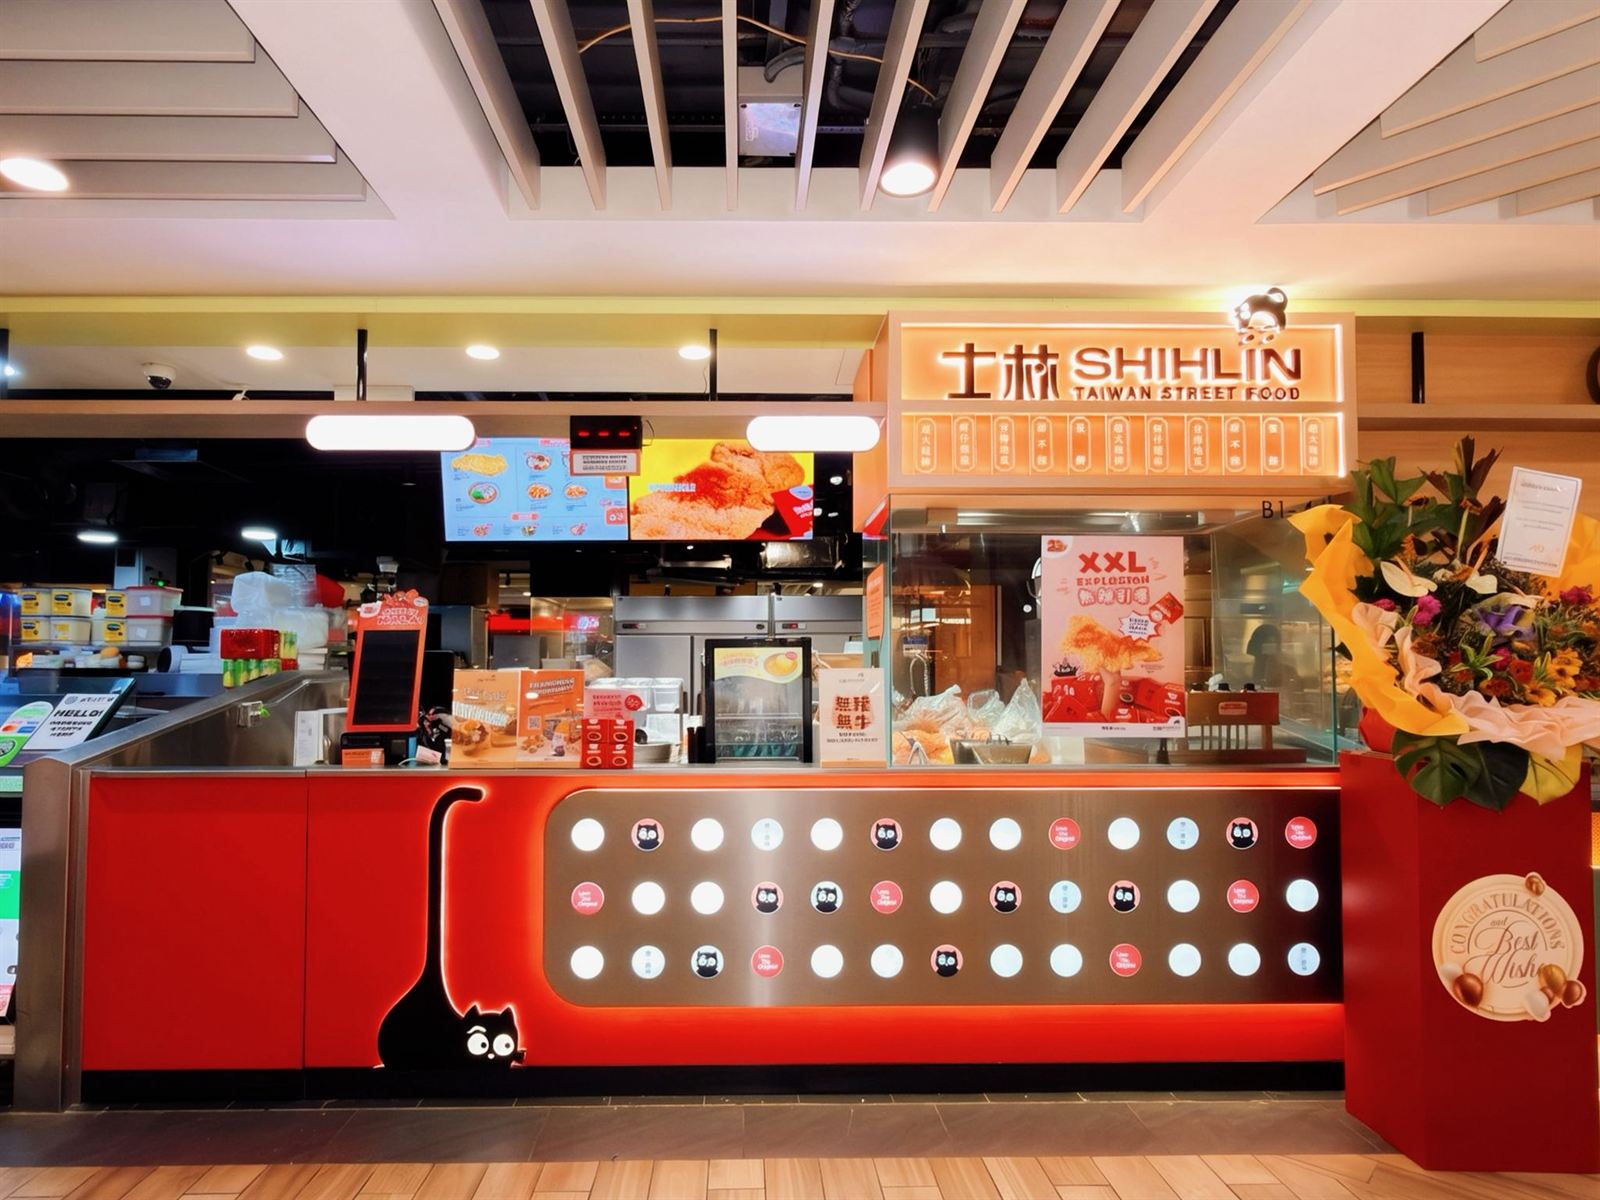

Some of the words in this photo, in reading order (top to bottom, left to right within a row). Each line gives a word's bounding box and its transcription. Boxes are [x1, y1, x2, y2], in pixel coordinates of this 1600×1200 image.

[942, 342, 1059, 400] 士林
[1074, 347, 1301, 380] SHIHLIN
[1075, 386, 1151, 400] TAIWAN
[1161, 386, 1236, 400] STREET
[1246, 386, 1300, 400] FOOD
[1078, 551, 1147, 574] XXL
[1076, 575, 1150, 586] EXPLOSION
[1475, 920, 1538, 954] Best
